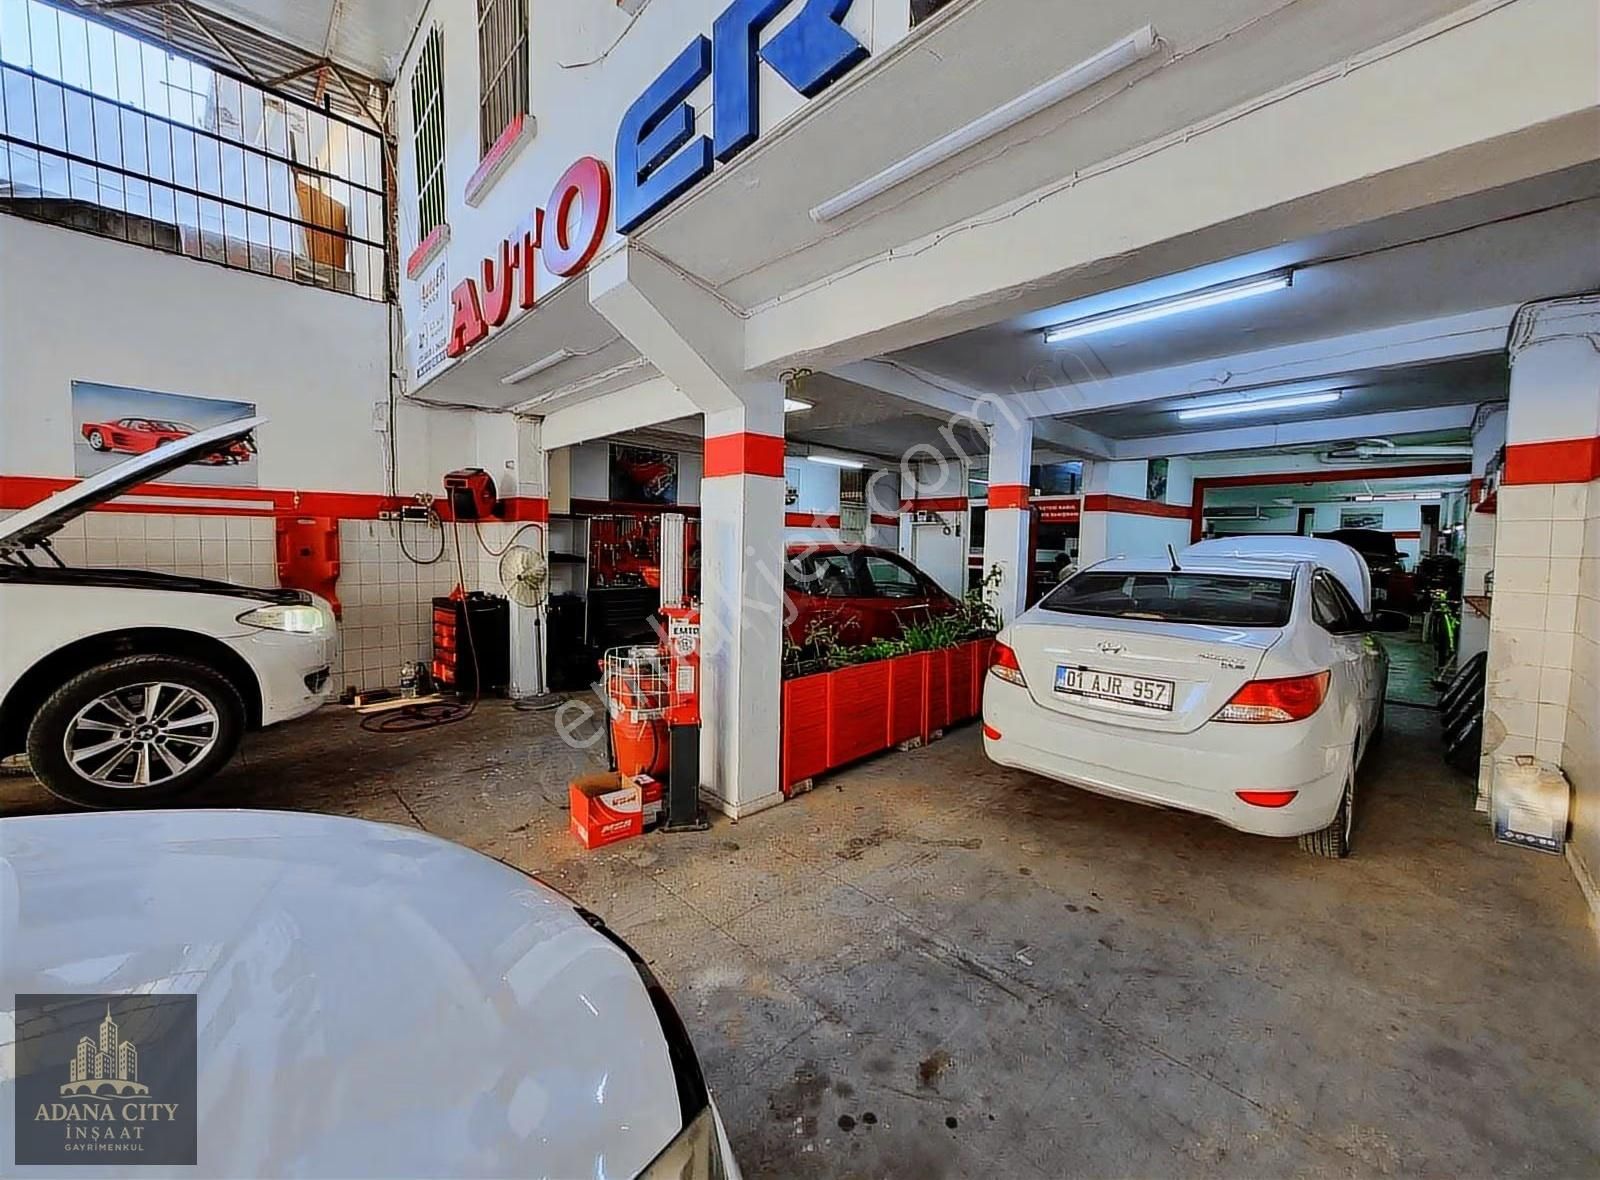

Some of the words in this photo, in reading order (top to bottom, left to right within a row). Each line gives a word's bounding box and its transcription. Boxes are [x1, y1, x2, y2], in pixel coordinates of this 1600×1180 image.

[447, 156, 611, 358] AUTO
[1066, 670, 1084, 690] 01
[1091, 675, 1123, 695] AJR
[1132, 681, 1167, 702] 957
